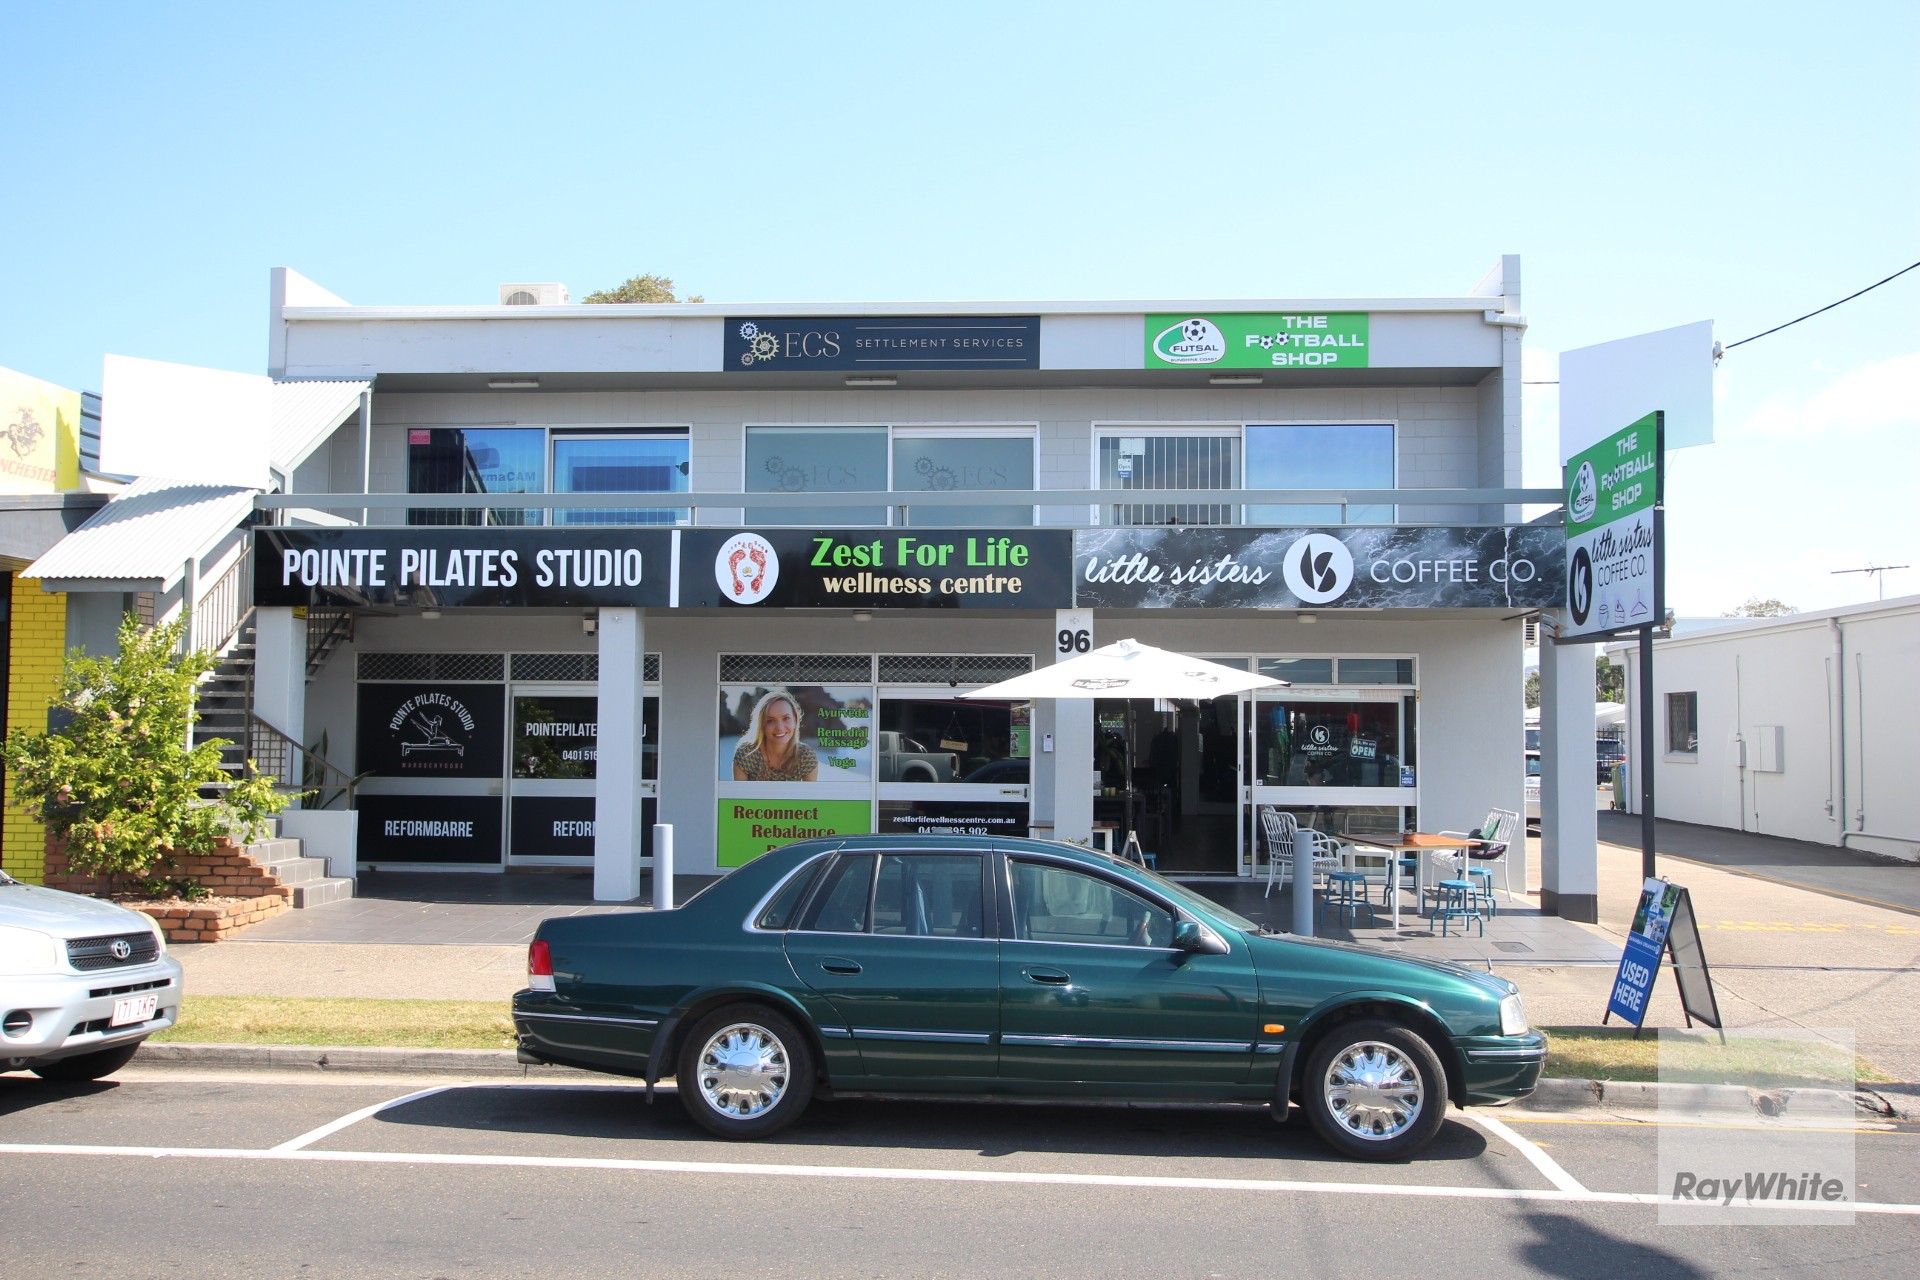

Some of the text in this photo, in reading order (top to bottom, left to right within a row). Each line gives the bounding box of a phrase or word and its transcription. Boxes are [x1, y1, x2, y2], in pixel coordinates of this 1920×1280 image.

[1282, 315, 1327, 329] THE
[784, 331, 1024, 358] ECS SETTLEMENT SERVICES
[1173, 344, 1219, 352] FUTSAL
[1272, 352, 1338, 366] SHOP
[1616, 431, 1637, 457] THE
[813, 464, 857, 486] ECS
[962, 464, 1008, 486] ECS
[1576, 493, 1594, 508] FUTSAL
[1612, 482, 1642, 511] SHOP
[1592, 518, 1654, 563] little sisters
[811, 537, 1029, 567] Zest For Life
[283, 548, 642, 587] POINTE PILATES STUDIO
[1085, 553, 1273, 585] little sisters
[1370, 559, 1542, 583] COFFEE CO.
[1598, 554, 1647, 587] COFFEE CO.
[823, 572, 1022, 594] wellness centre
[1058, 629, 1090, 653] 96
[389, 693, 475, 731] POINTE PILATES STUDIO
[817, 707, 869, 720] Ayurveda
[817, 727, 868, 738] Remedial
[818, 737, 867, 750] Massage
[562, 750, 582, 761] 0401
[1352, 745, 1375, 757] OPEN
[828, 756, 857, 769] Yoga
[734, 805, 819, 820] Reconnect
[893, 815, 1016, 824] zestforlifewellnesscentre.com.au
[384, 820, 473, 837] REFORMBARRE
[752, 824, 836, 839] Rebalance
[969, 827, 988, 835] 902
[1621, 958, 1650, 989] USED
[1613, 980, 1643, 1012] HERE
